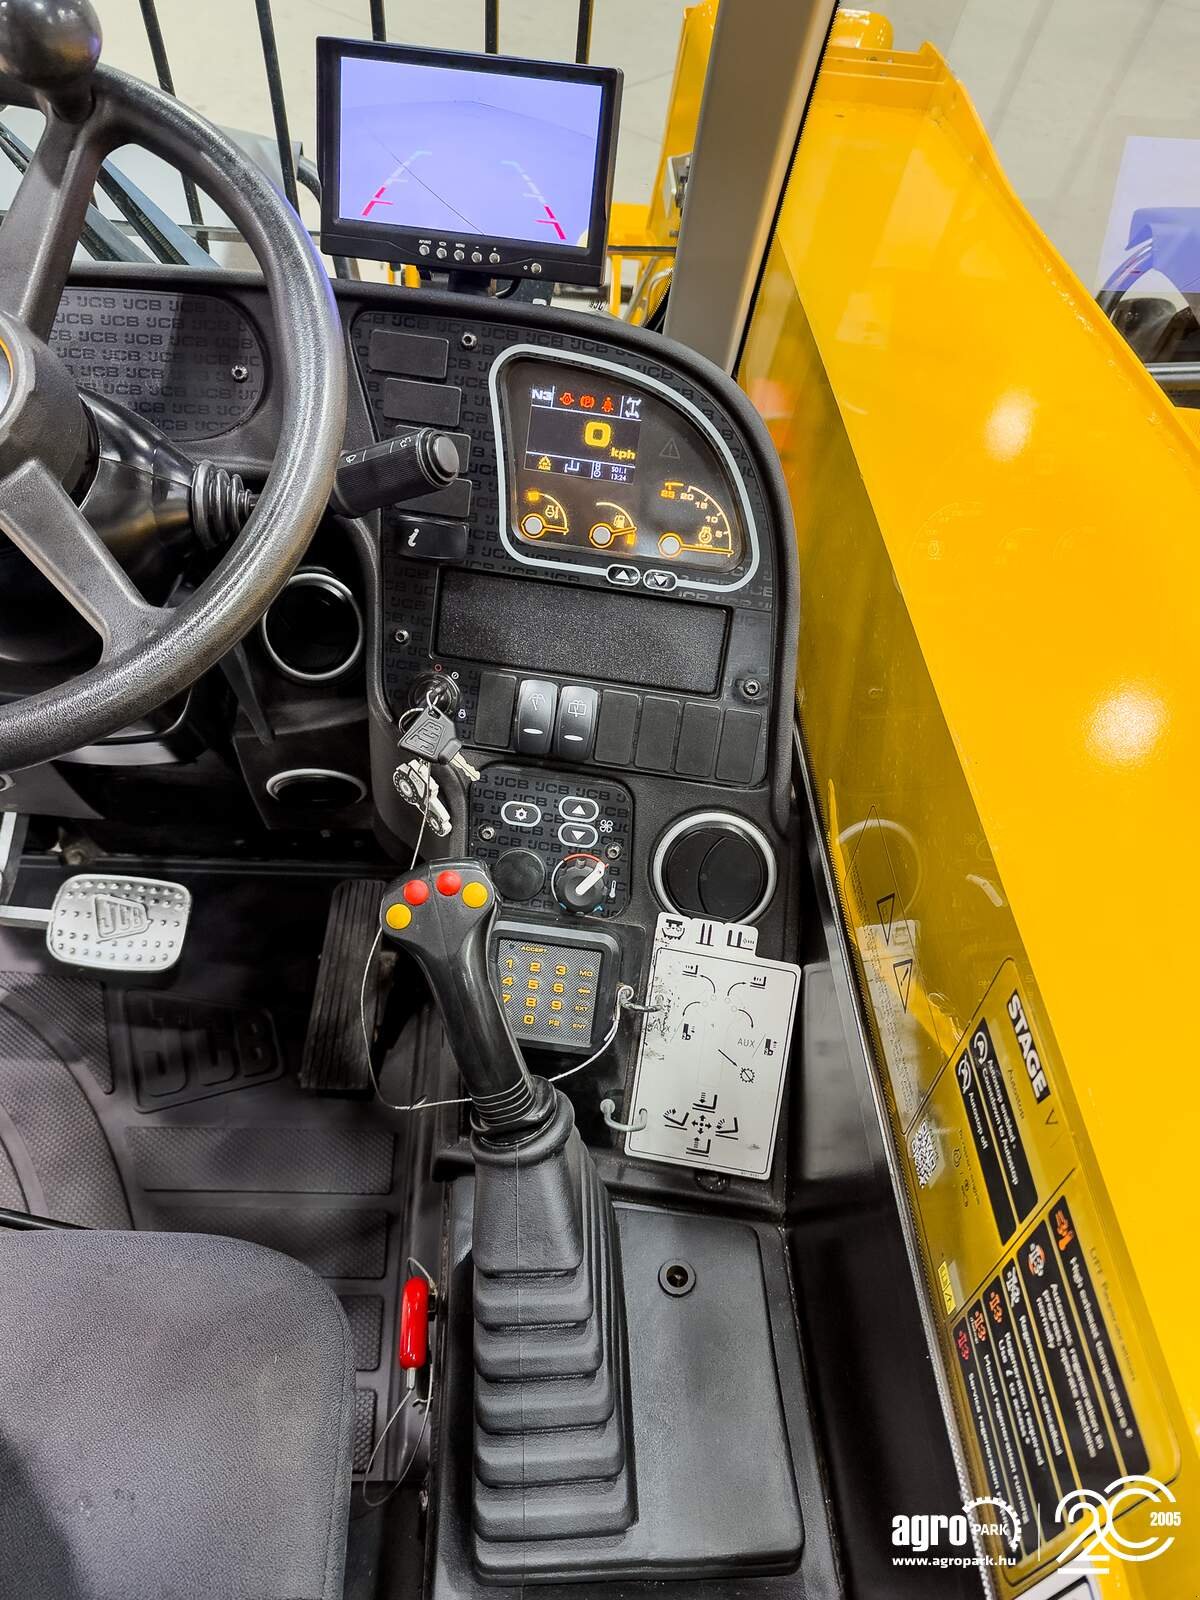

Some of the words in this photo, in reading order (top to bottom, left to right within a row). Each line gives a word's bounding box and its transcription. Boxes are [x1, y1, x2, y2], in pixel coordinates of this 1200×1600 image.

[123, 296, 162, 311] JCB
[100, 314, 139, 327] JCB
[147, 316, 185, 329] JCB
[78, 330, 118, 343] JCB
[124, 332, 163, 345] JCB
[57, 347, 95, 360] JCB
[102, 349, 141, 361] JCB
[80, 365, 119, 378] JCB
[126, 366, 164, 379] JCB
[104, 382, 143, 395] JCB
[148, 385, 187, 397] JCB
[531, 388, 551, 401] N3
[584, 421, 612, 448] 0
[610, 448, 636, 460] kph
[610, 473, 627, 482] 13:24
[704, 515, 718, 524] 10
[410, 720, 443, 756] JCB
[494, 775, 530, 790] JCB
[535, 780, 570, 795] JCB
[576, 786, 610, 801] JCB
[474, 787, 507, 802] JCB
[512, 793, 548, 807] JCB
[528, 839, 562, 853] JCB
[100, 901, 148, 932] JCB
[506, 959, 514, 969] 1
[529, 961, 541, 972] 2
[555, 965, 567, 976] 3
[502, 976, 514, 986] 4
[527, 979, 539, 990] 5
[553, 982, 565, 993] 6
[502, 992, 512, 1003] 7
[525, 997, 537, 1007] 8
[551, 1000, 562, 1011] 9
[523, 1014, 535, 1025] 0
[737, 1037, 756, 1049] AUX
[1006, 990, 1047, 1100] STAGE
[987, 1056, 1004, 1104] Autostop
[967, 1089, 983, 1137] Autostop
[979, 1133, 988, 1151] off
[981, 1065, 1001, 1126] Countdown
[997, 1124, 1004, 1138] to
[1001, 1135, 1019, 1187] Autostop
[1019, 1314, 1044, 1395] Regeneration
[1004, 1331, 1028, 1411] Regeneration
[982, 1353, 997, 1396] Manual
[993, 1395, 1016, 1473] regeneration
[967, 1371, 982, 1414] Service
[978, 1413, 1000, 1491] regeneration
